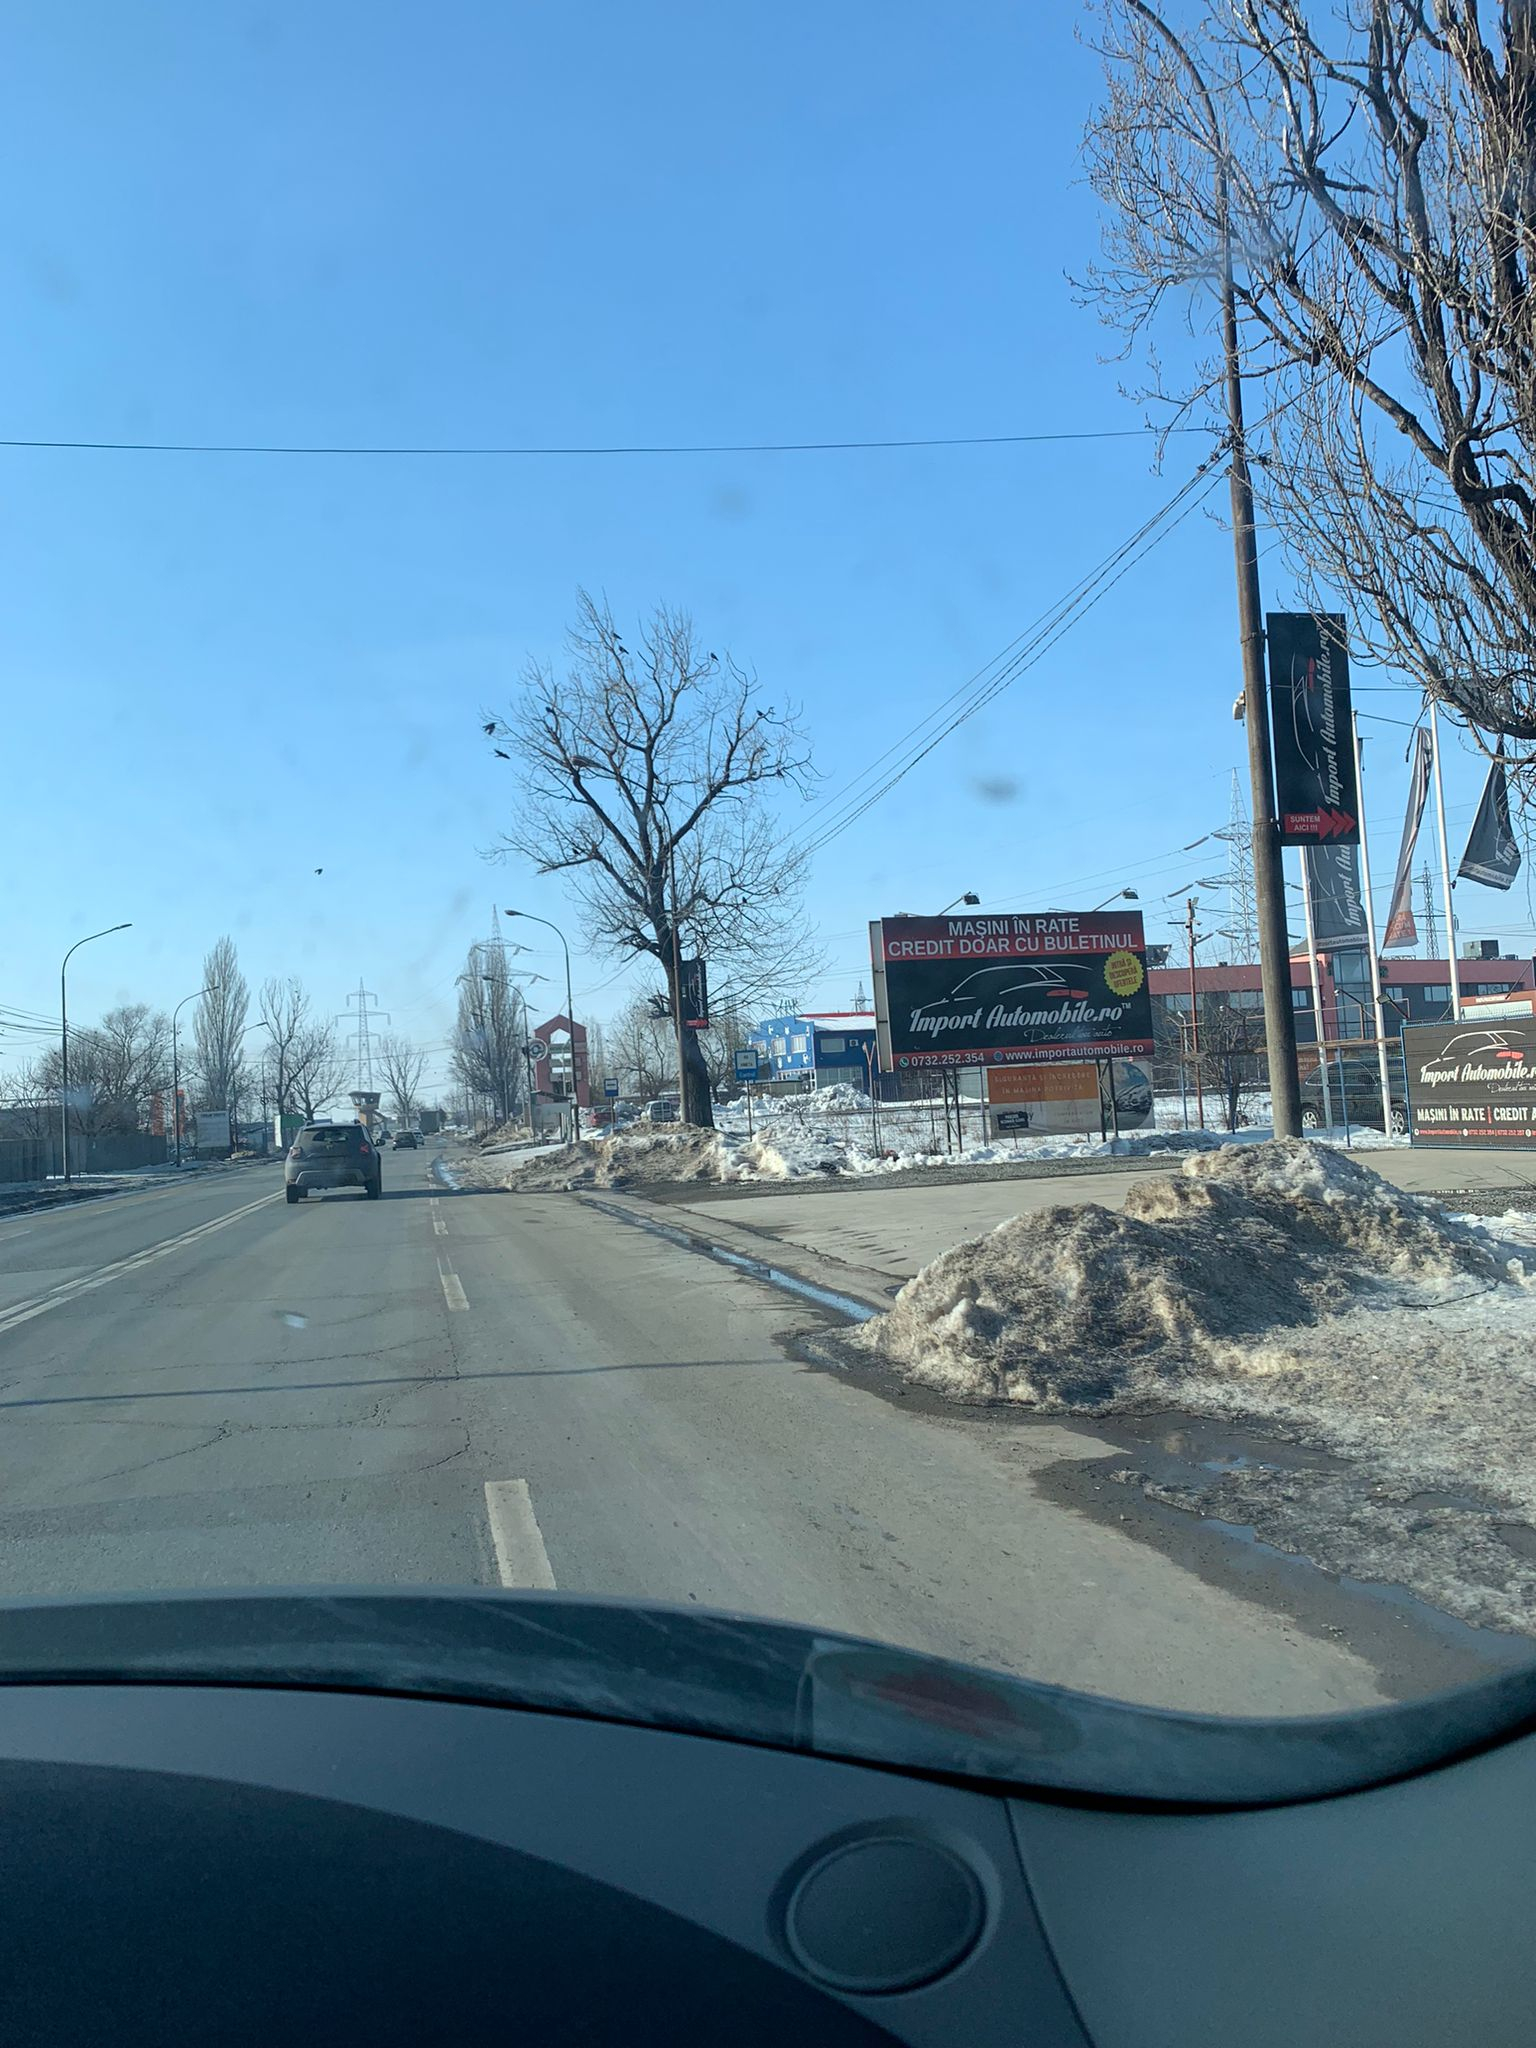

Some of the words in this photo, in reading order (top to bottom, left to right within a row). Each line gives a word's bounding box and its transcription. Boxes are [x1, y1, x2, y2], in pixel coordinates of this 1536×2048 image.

[1323, 744, 1343, 806] Import
[1290, 815, 1320, 823] SUNTEM
[1012, 916, 1031, 934] ÎN
[1035, 918, 1080, 933] RATE
[888, 939, 955, 956] CREDIT
[960, 938, 1010, 954] DOAR
[1015, 937, 1039, 952] CU
[1044, 934, 1138, 951] BULETINUL
[909, 1007, 983, 1038] Import
[911, 1052, 984, 1067] 0732.252.354
[1005, 1044, 1144, 1061] www.importautomobile.ro
[1420, 1064, 1460, 1088] Import
[1449, 1104, 1459, 1121] ÎN
[1461, 1107, 1486, 1121] RATE
[1493, 1107, 1528, 1121] CREDIT
